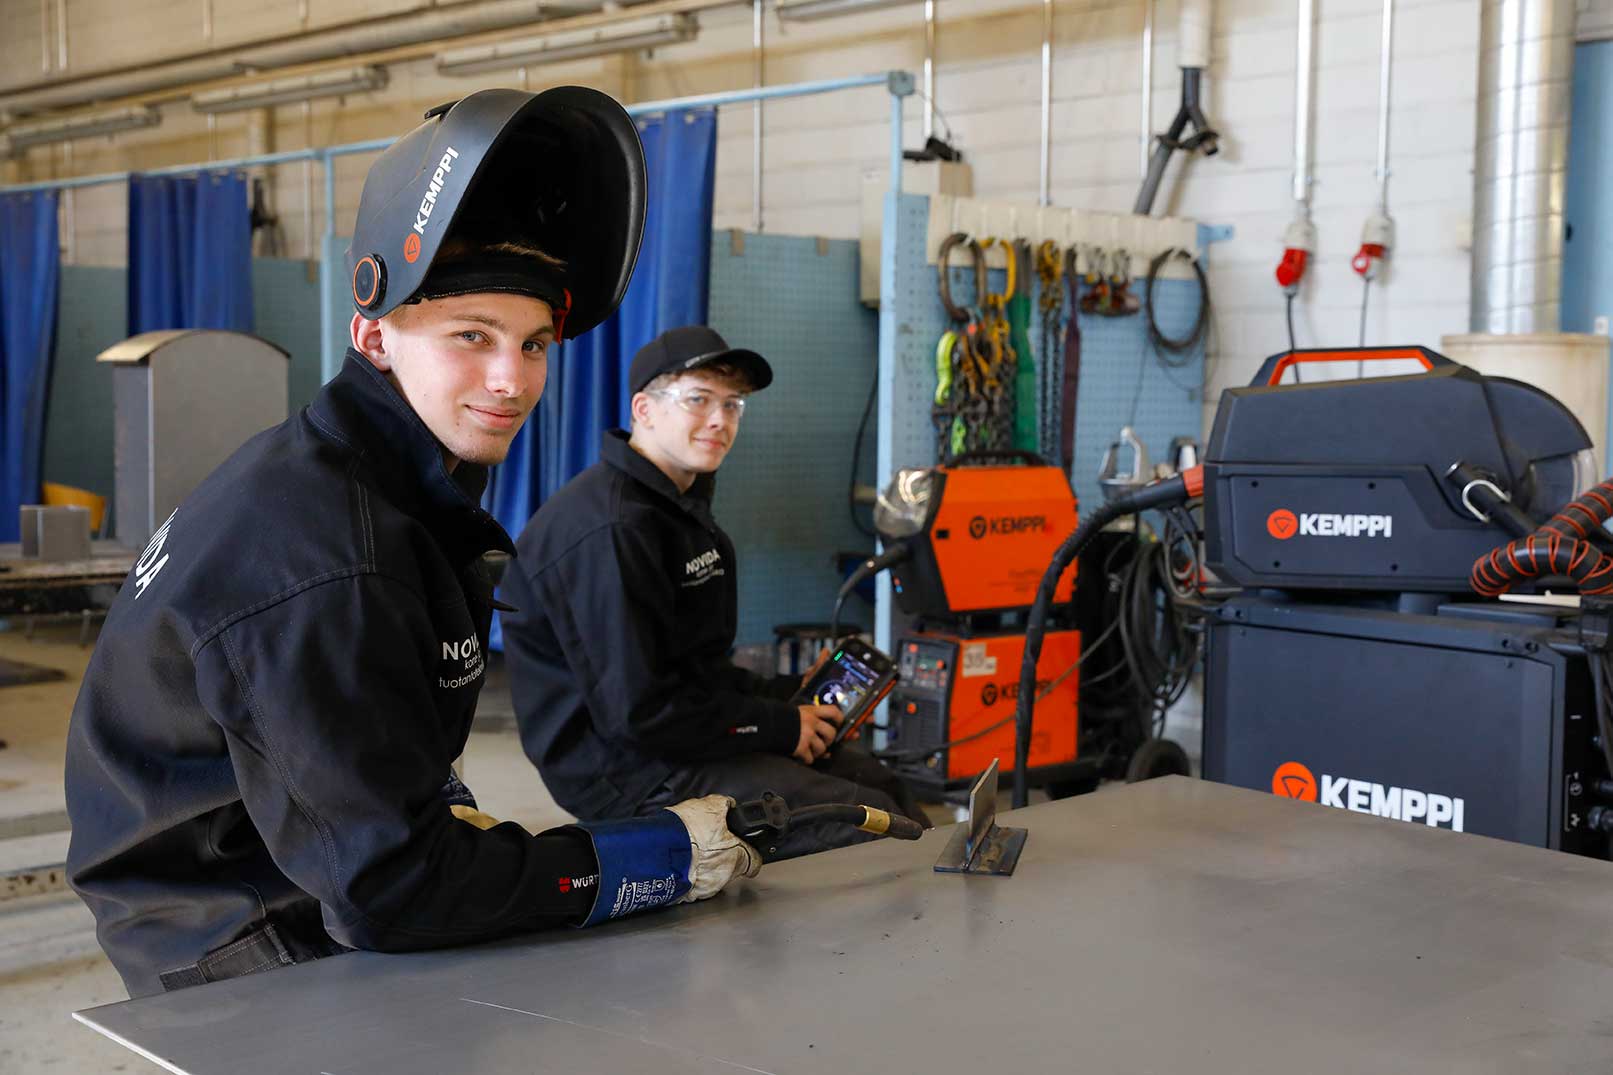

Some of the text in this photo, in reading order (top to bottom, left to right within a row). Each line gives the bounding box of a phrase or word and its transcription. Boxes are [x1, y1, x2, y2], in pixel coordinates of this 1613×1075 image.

[413, 147, 459, 234] KEMPPI
[990, 515, 1046, 535] KEMPPI
[1299, 513, 1393, 538] KEMPPI
[685, 548, 721, 575] NOVIDA
[1321, 774, 1465, 833] KEMPPI
